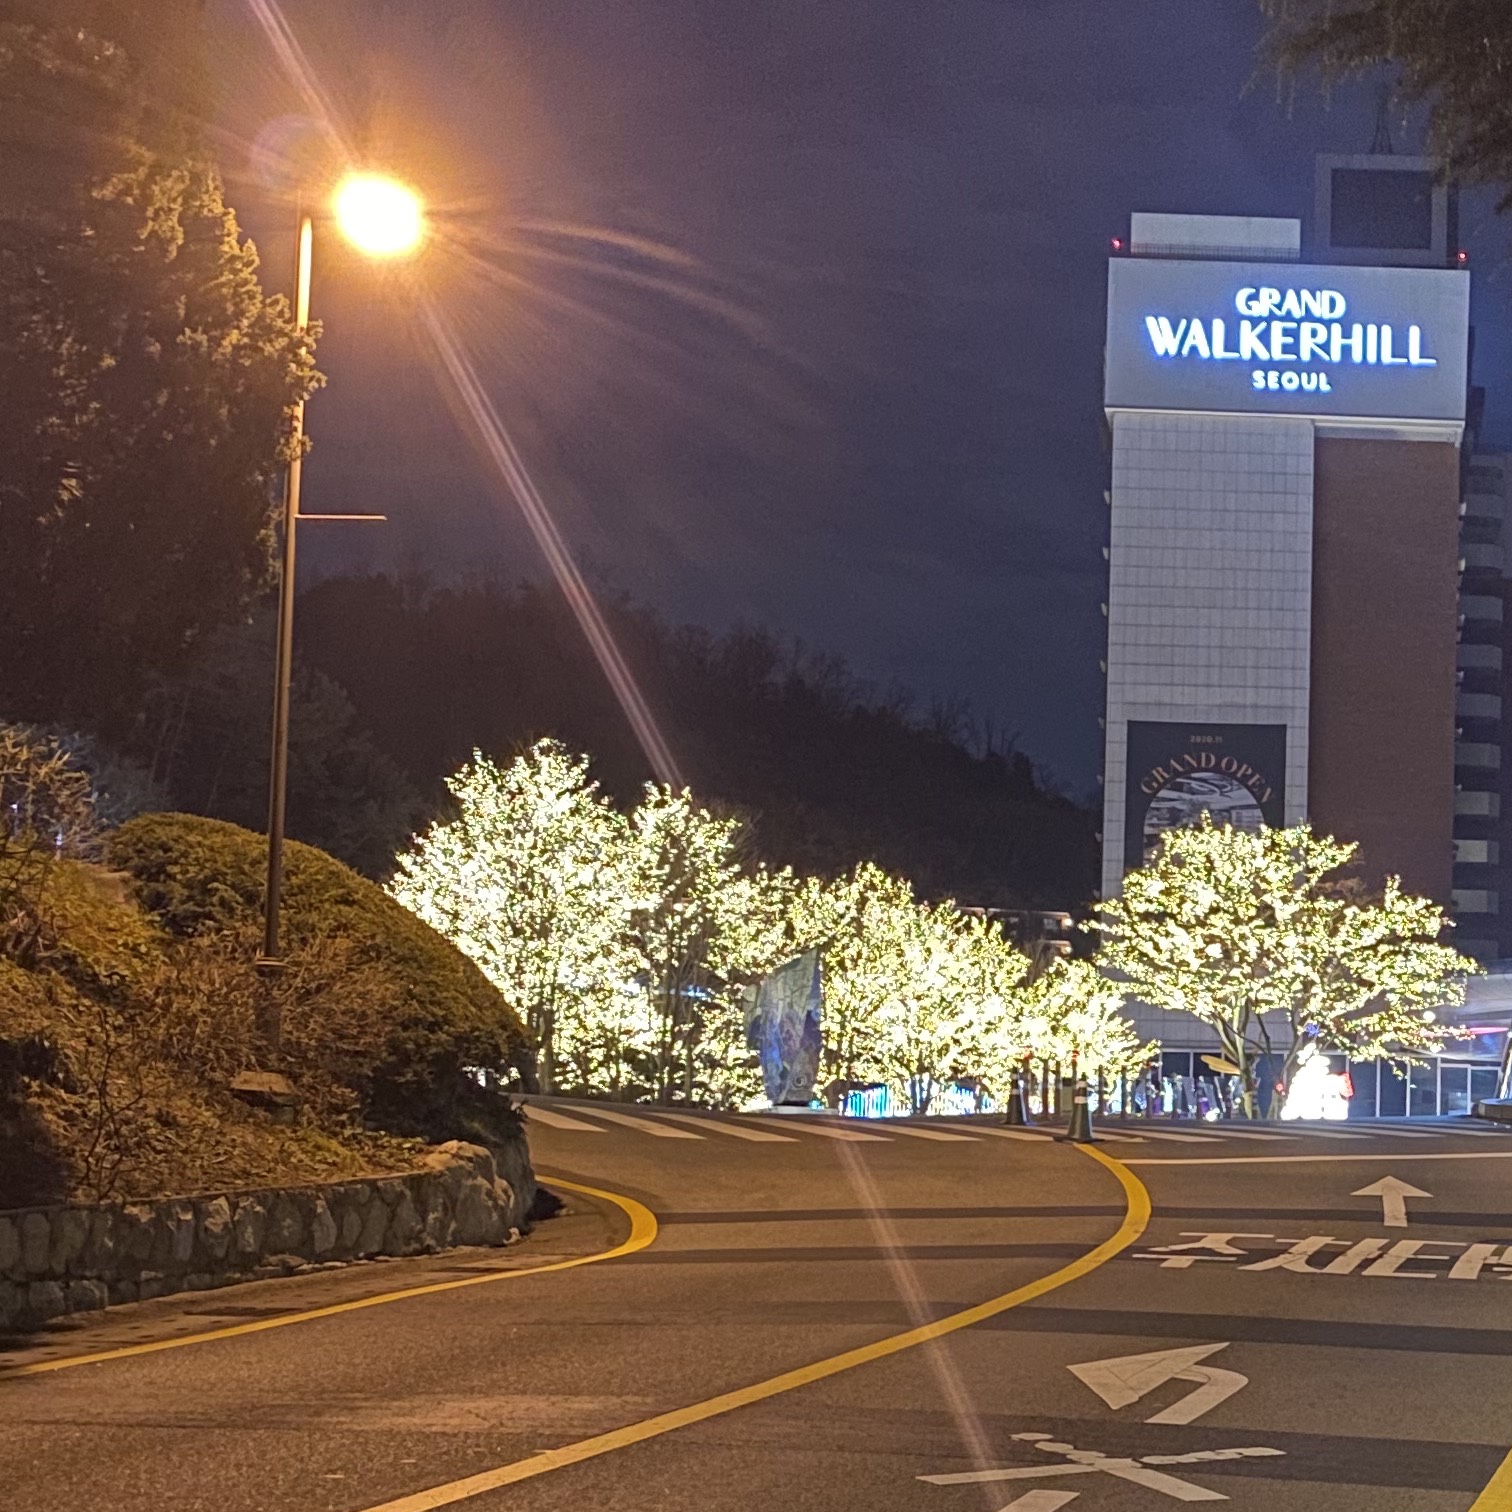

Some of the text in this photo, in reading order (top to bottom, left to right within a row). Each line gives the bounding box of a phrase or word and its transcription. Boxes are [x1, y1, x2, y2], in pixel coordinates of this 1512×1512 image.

[1235, 287, 1346, 319] GRAND
[1145, 315, 1437, 367] WALKERHILL
[1252, 370, 1332, 391] SEOUL
[1141, 752, 1272, 803] GRAND OPEN
